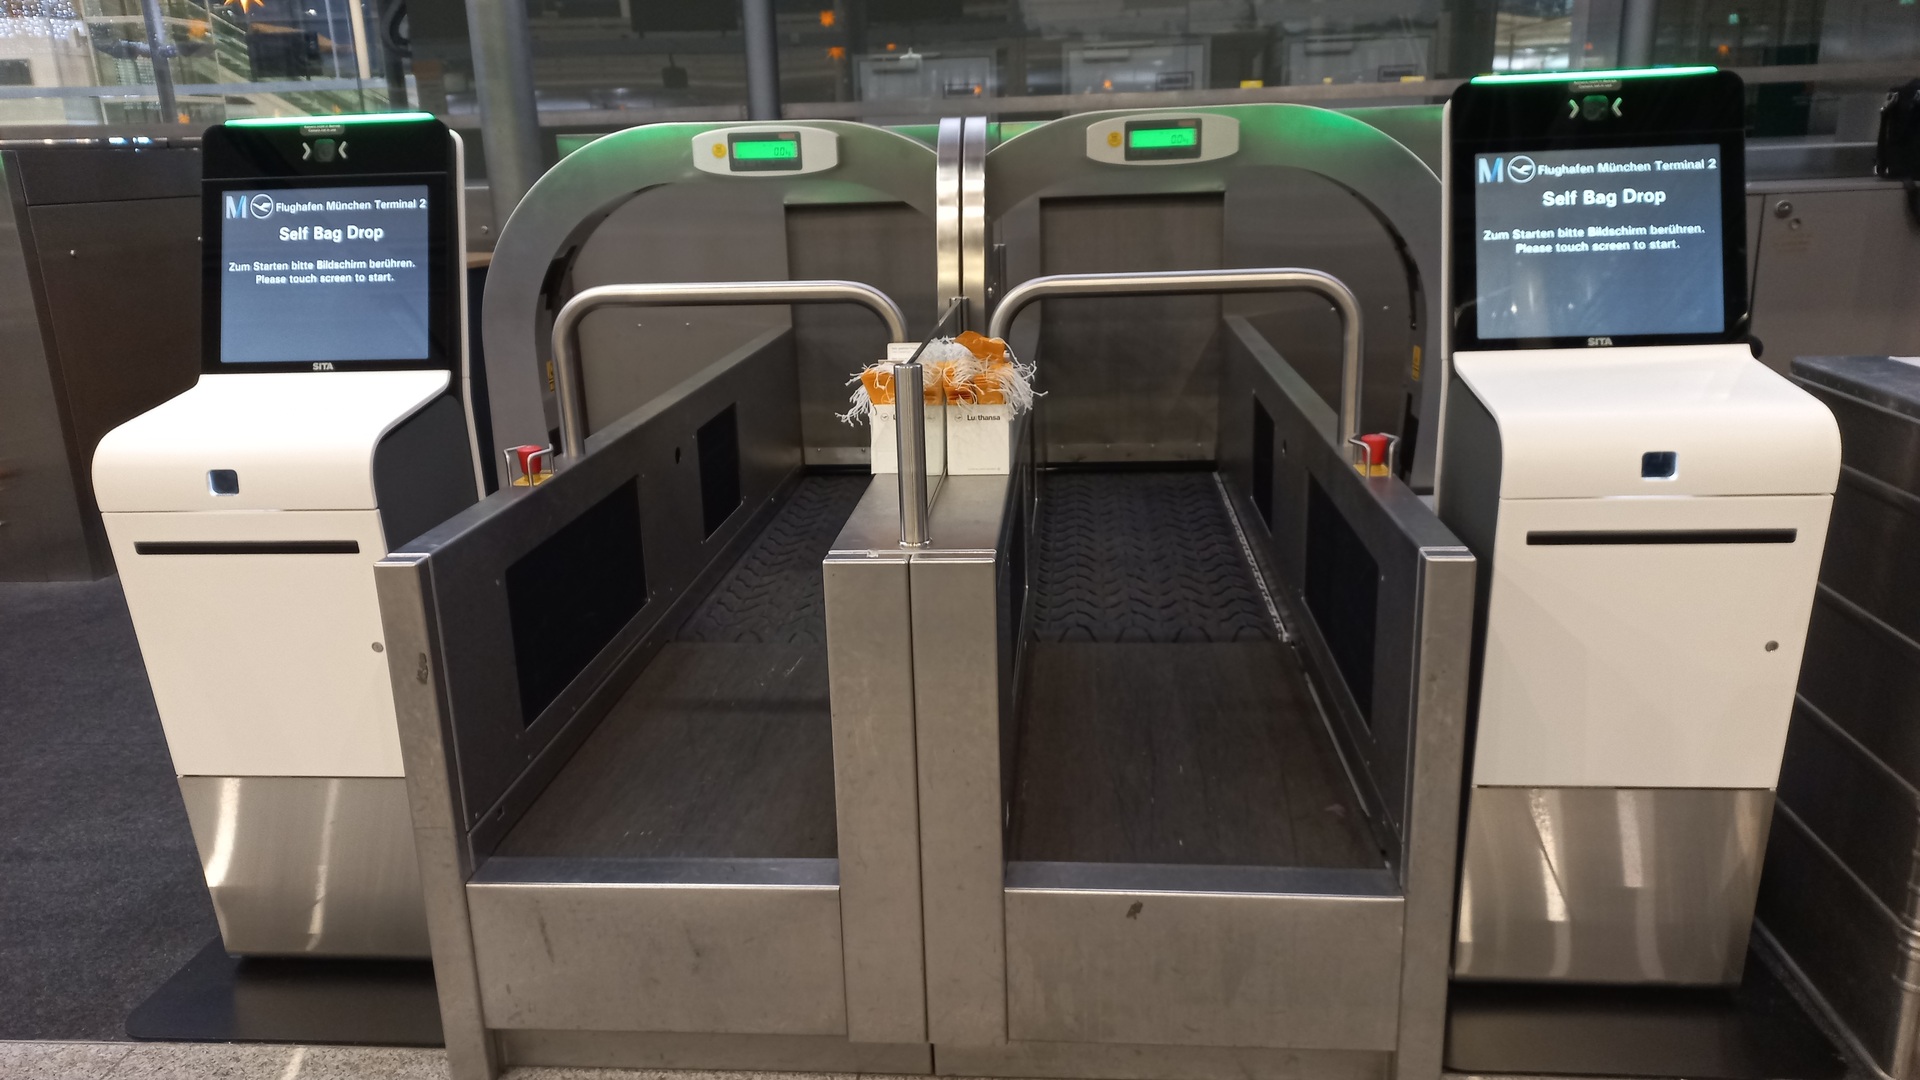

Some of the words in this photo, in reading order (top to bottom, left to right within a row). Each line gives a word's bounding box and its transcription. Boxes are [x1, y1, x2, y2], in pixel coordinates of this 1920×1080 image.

[1478, 157, 1503, 183] M
[1537, 164, 1594, 177] Flughafen
[1597, 162, 1651, 173] München
[1654, 159, 1705, 171] Terminal
[1708, 158, 1718, 169] 2
[1542, 190, 1577, 207] Self
[1583, 190, 1617, 207] Bag
[1622, 188, 1666, 206] Drop
[225, 195, 247, 218] M
[276, 202, 323, 214] Flughafen
[326, 200, 371, 211] München
[375, 199, 416, 209] Terminal
[419, 199, 427, 208] 2
[279, 226, 309, 241] Self
[313, 226, 343, 242] Bag
[347, 225, 384, 241] Drop
[1483, 230, 1509, 241] Zum
[1512, 228, 1555, 239] Starten
[1557, 227, 1584, 238] bitte
[1588, 225, 1647, 237] Bildschirm
[1649, 224, 1705, 235] berühren.
[1516, 243, 1552, 254] Please
[1555, 241, 1589, 252] touch
[1592, 241, 1630, 251] screen
[1633, 240, 1646, 250] to
[1649, 239, 1680, 250] start.
[229, 262, 250, 272] Zum
[254, 261, 288, 271] Starten
[291, 260, 314, 270] bitte
[317, 259, 367, 270] Bildschirm
[369, 258, 416, 268] berühren.
[256, 274, 286, 284] Please
[289, 274, 317, 283] touch
[320, 274, 352, 283] screen
[355, 273, 365, 282] to
[368, 272, 394, 282] start.
[1587, 336, 1613, 346] SITA
[312, 362, 333, 371] SITA
